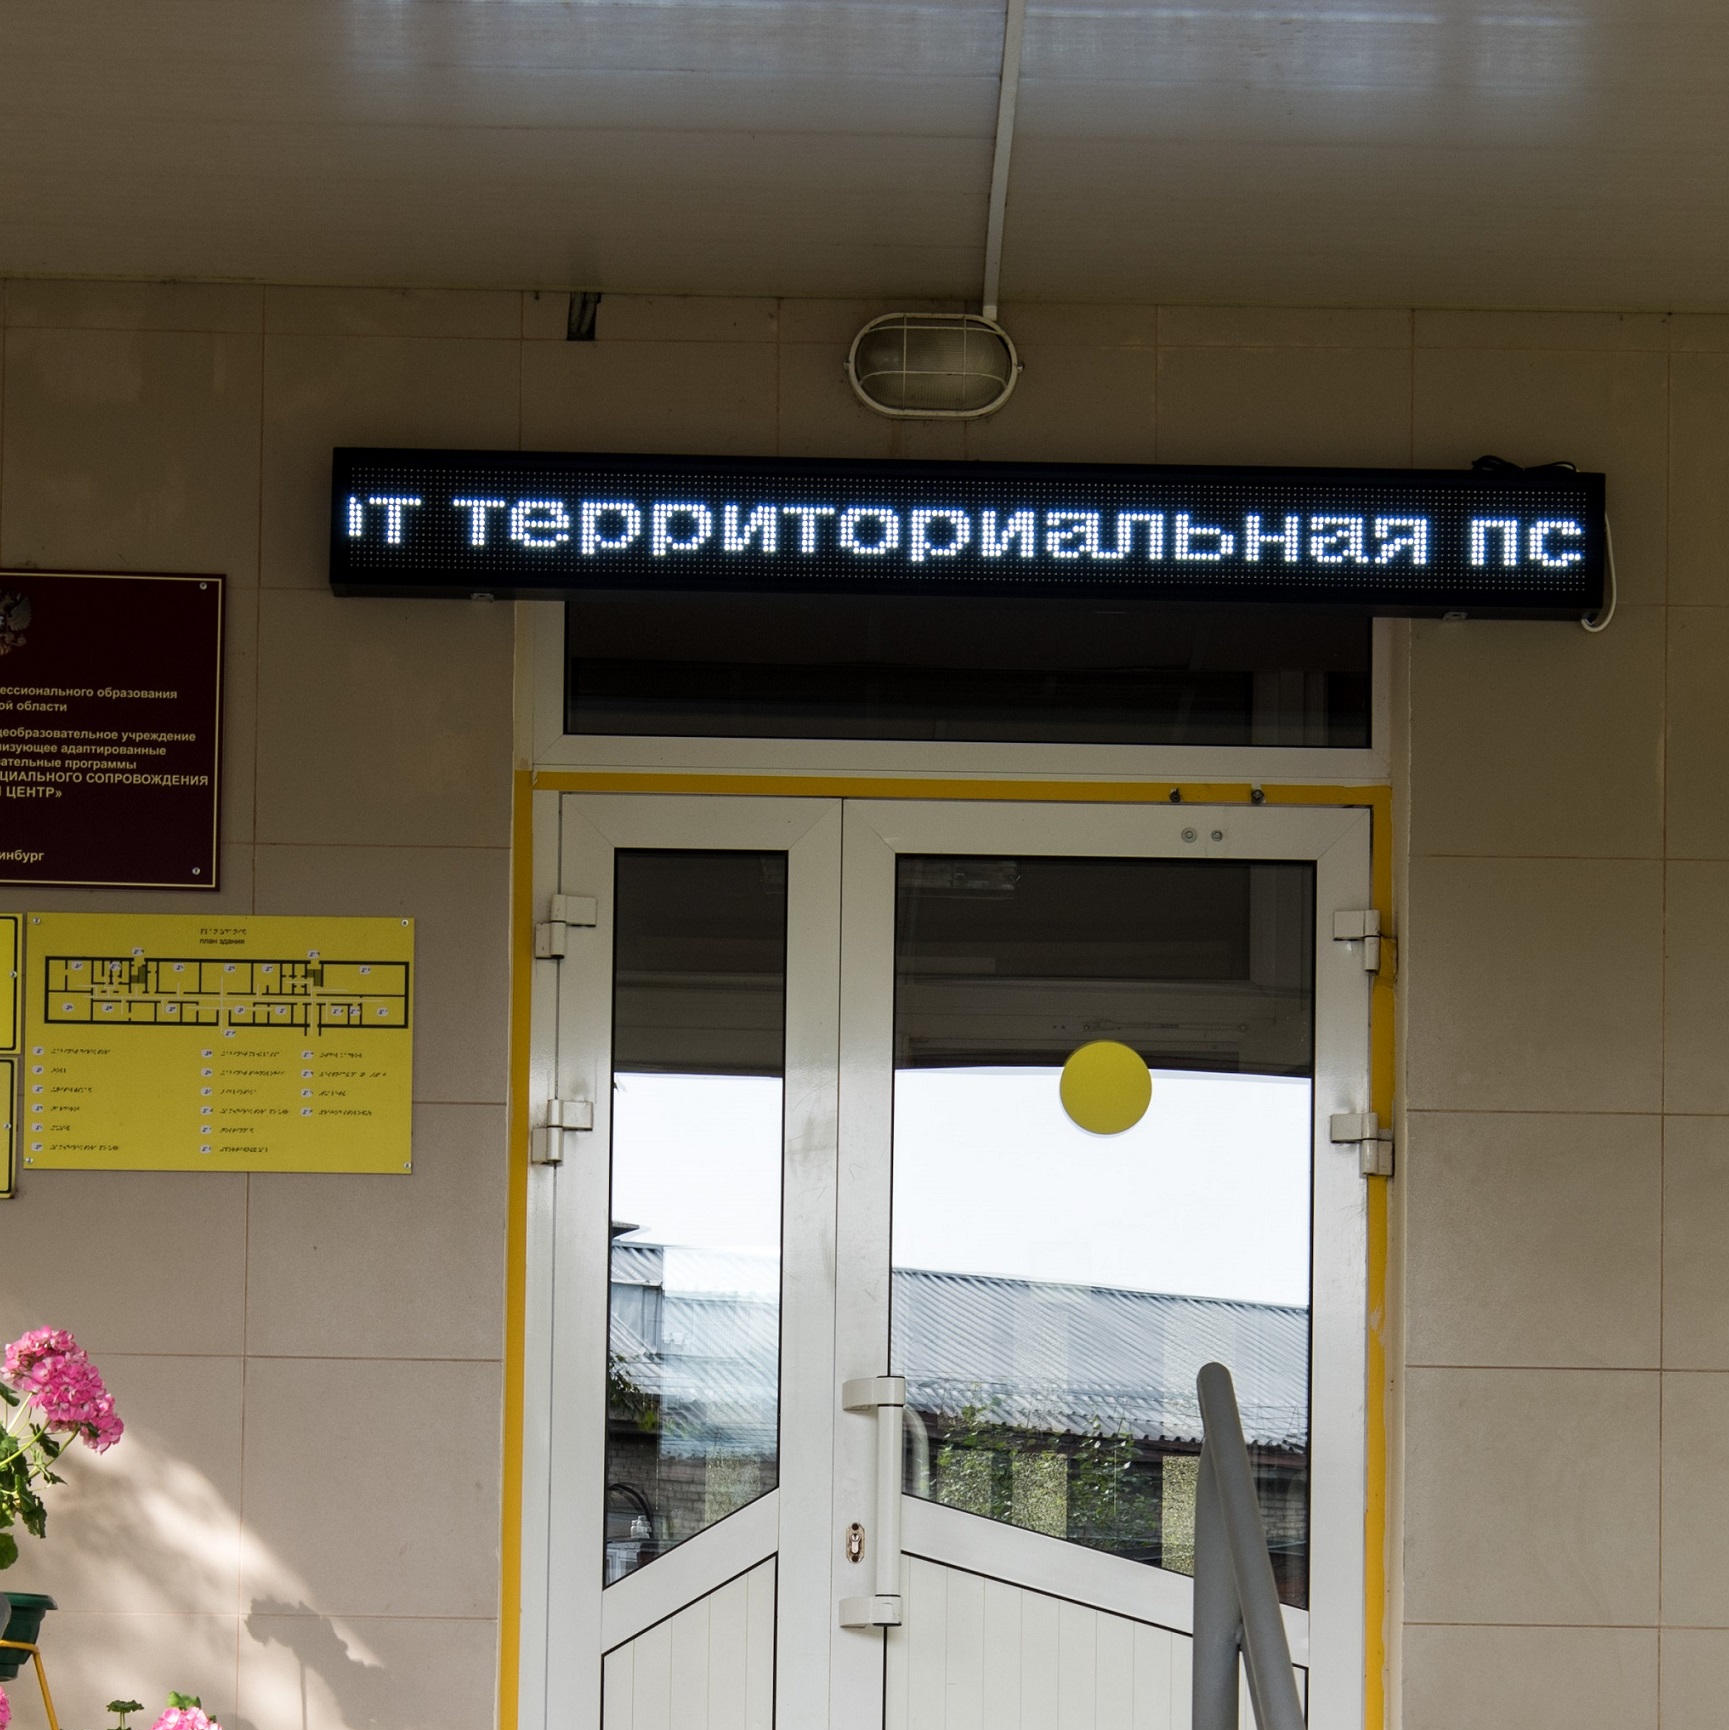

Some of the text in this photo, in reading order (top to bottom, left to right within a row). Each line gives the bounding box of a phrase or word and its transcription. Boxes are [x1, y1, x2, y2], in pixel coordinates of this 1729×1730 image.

[453, 496, 1427, 568] территориальная
[1471, 517, 1582, 567] пс
[97, 688, 177, 699] образования
[17, 702, 67, 712] области
[121, 732, 196, 742] учреждение
[61, 746, 166, 756] адаптированные
[65, 760, 136, 770] программы
[86, 773, 208, 786] СОПРОВОЖДЕНИЯ
[7, 786, 62, 799] ЦЕНТР»
